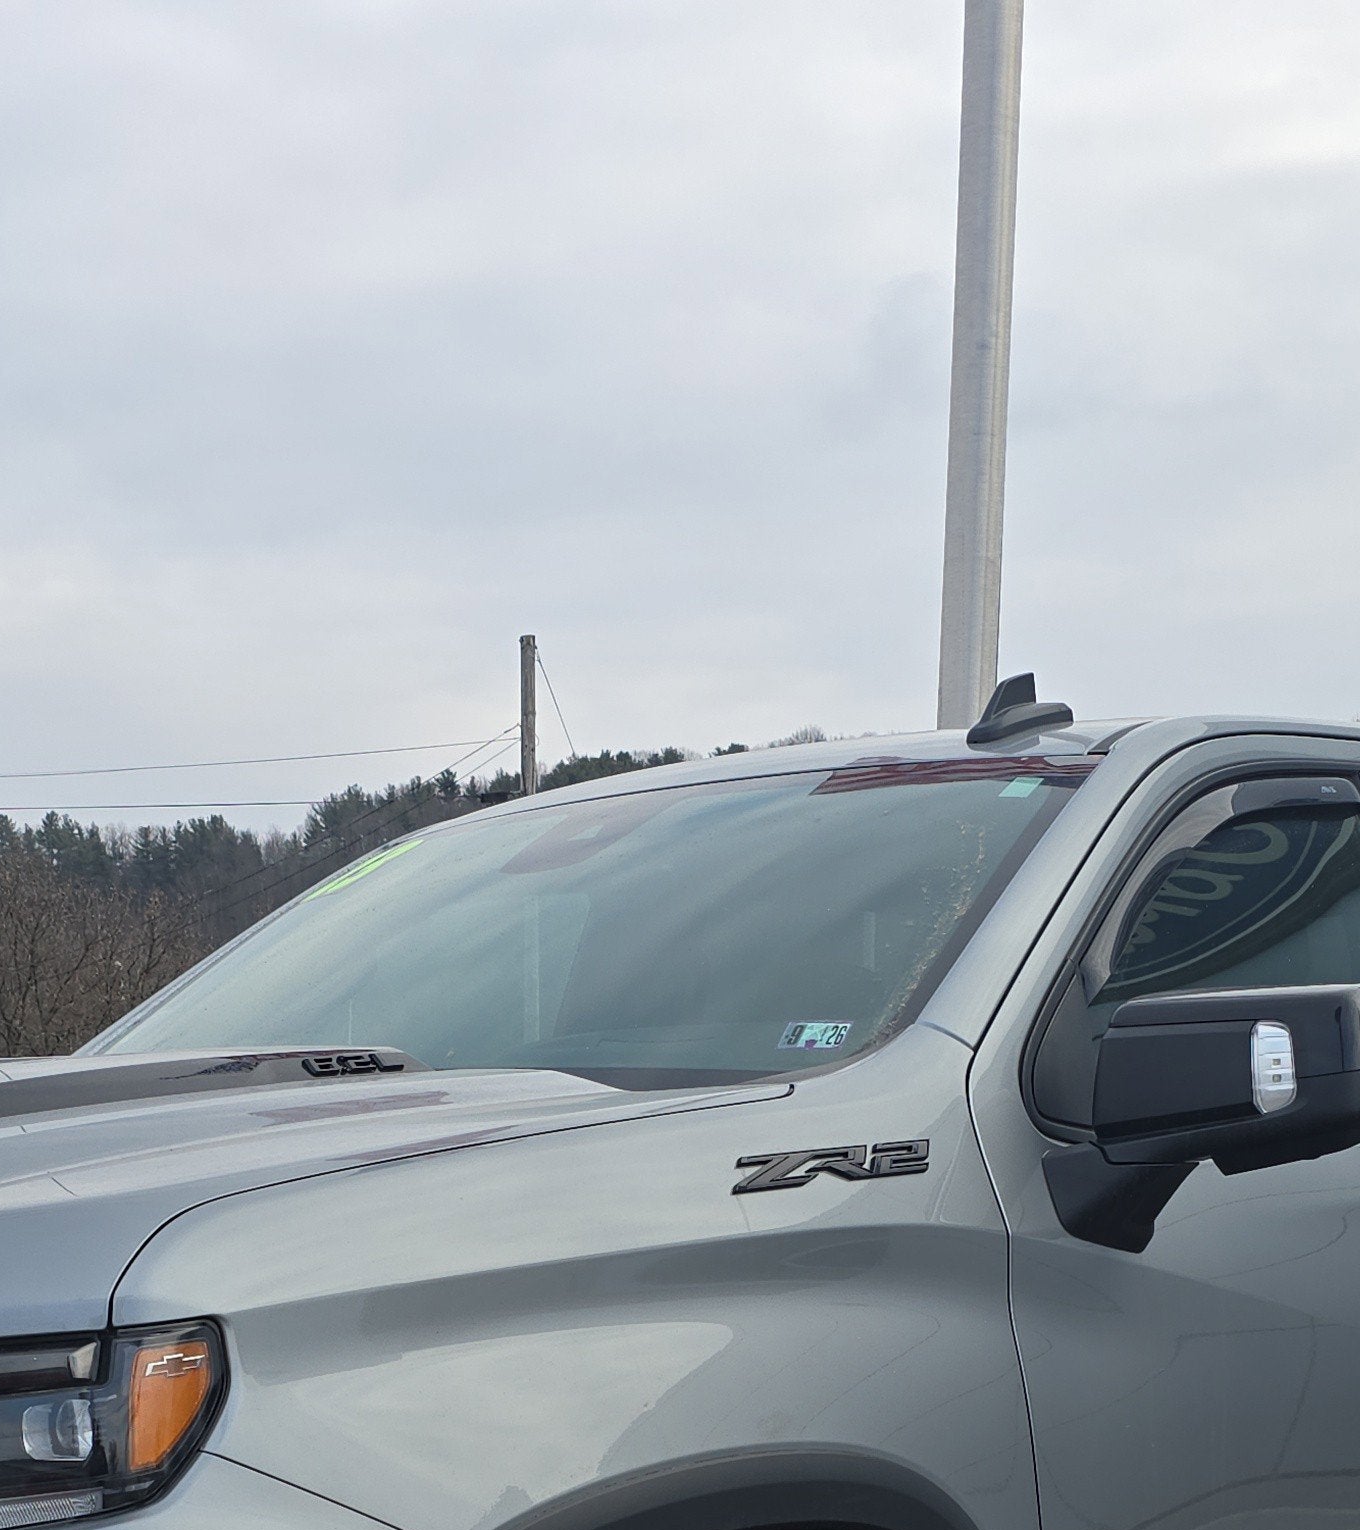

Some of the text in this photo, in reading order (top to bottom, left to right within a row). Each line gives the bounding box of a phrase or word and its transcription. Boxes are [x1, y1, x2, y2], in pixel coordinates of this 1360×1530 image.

[787, 1024, 848, 1046] 9 26
[731, 1139, 930, 1195] ZR2
